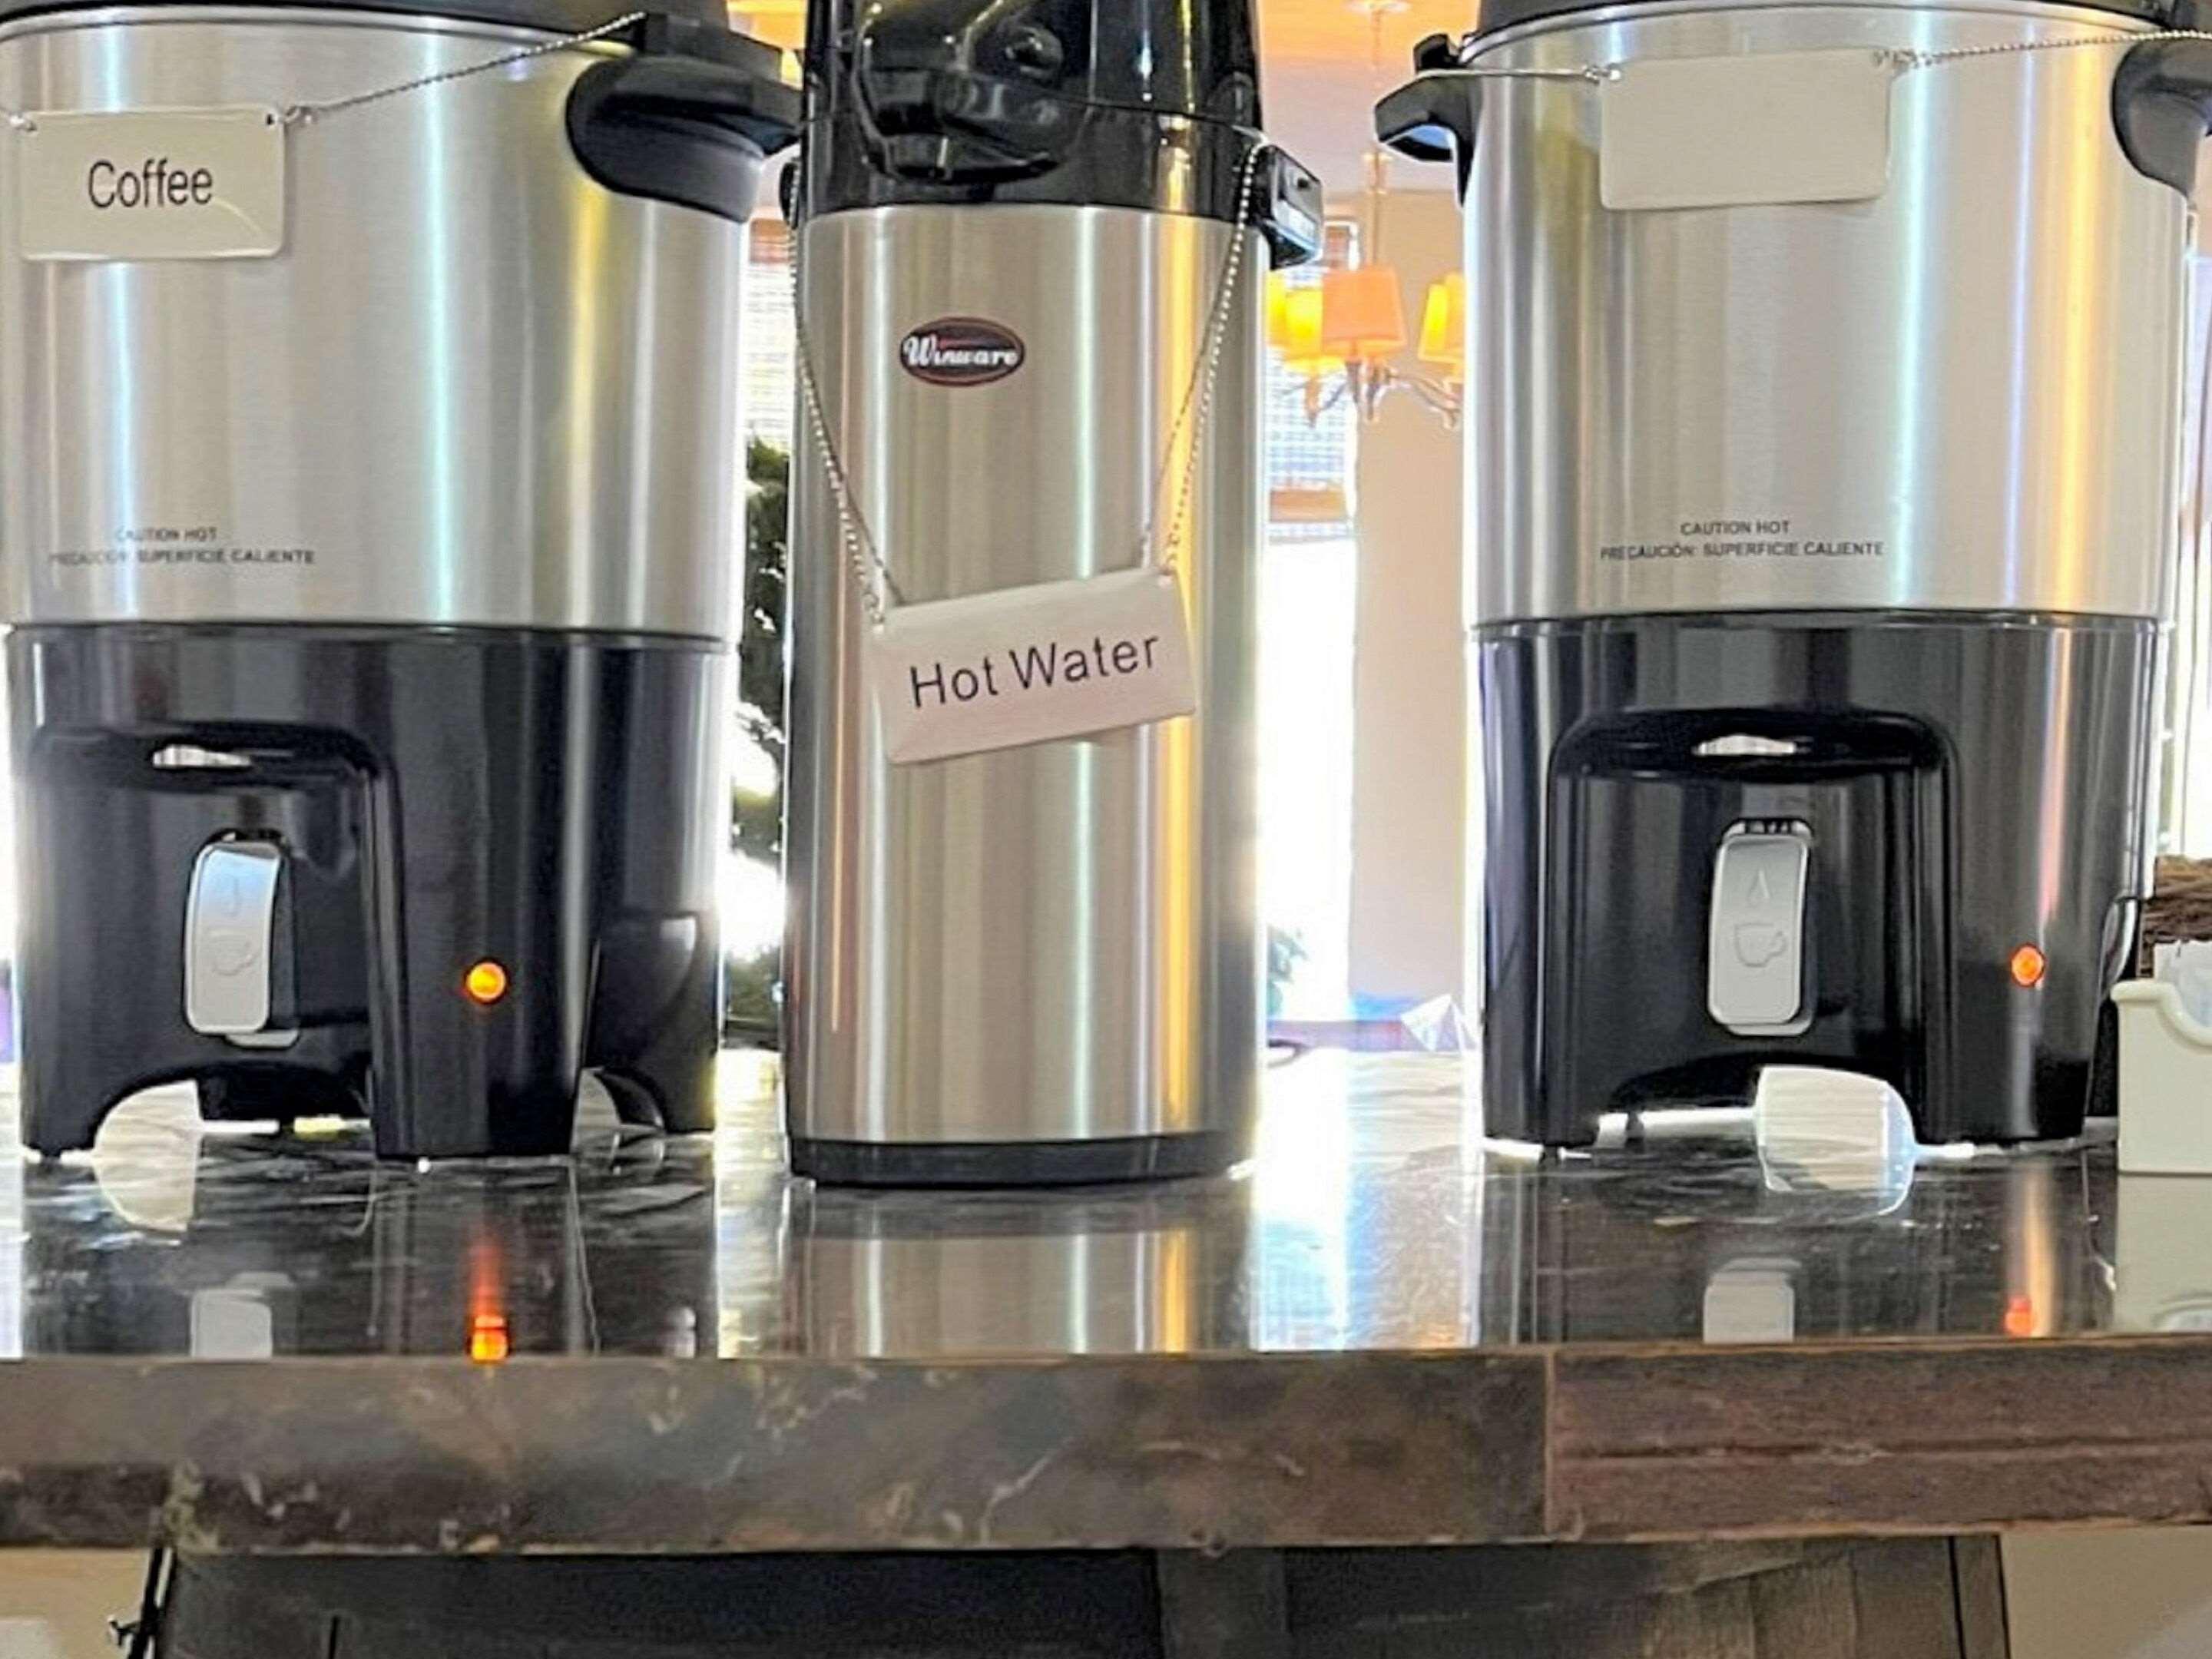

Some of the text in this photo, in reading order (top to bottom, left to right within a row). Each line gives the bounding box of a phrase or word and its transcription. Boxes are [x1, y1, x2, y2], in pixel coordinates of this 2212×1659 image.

[88, 157, 213, 208] Coffee
[902, 333, 1018, 366] Winware
[184, 527, 217, 541] HOT
[1680, 519, 1790, 535] CAUTION HOT
[1703, 542, 1799, 557] SUPERFICIE
[1803, 541, 1884, 556] CALIENTE
[909, 635, 1159, 707] Hot Water
